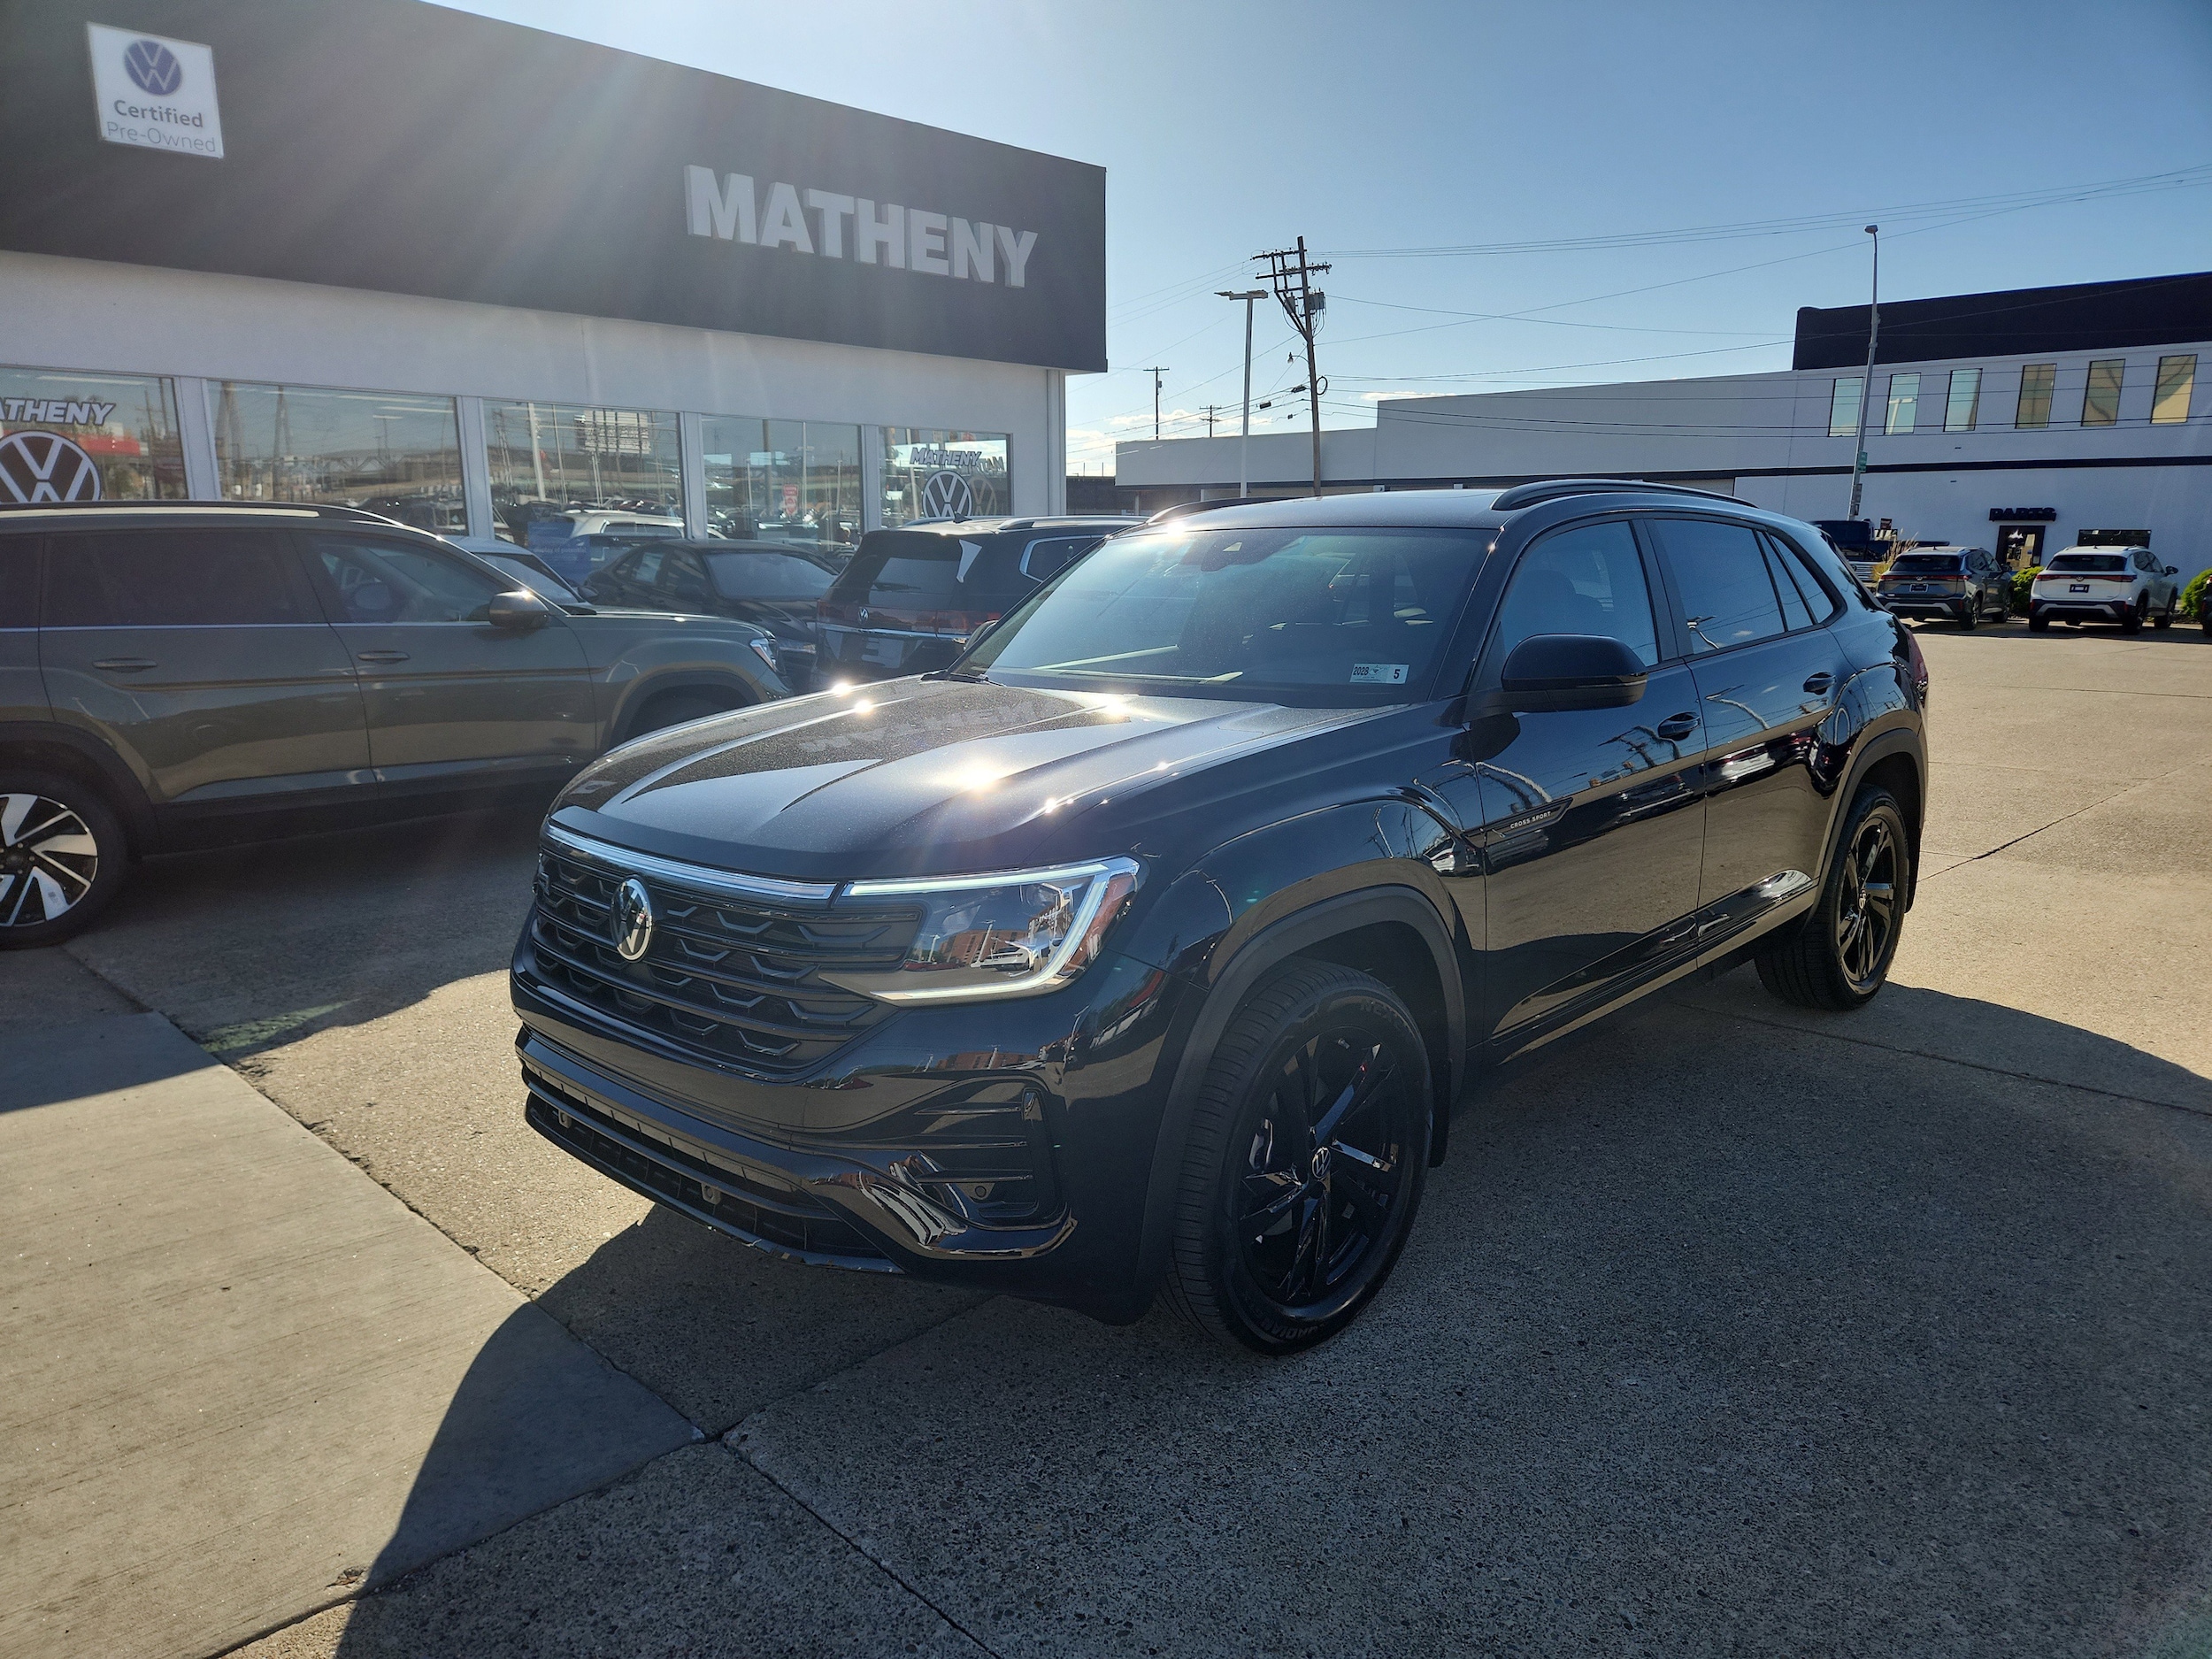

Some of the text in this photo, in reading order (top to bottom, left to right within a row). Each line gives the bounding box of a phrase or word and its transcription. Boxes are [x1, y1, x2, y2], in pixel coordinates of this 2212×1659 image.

[113, 99, 204, 128] Certified
[106, 120, 216, 153] Pre-Owned
[683, 165, 1039, 288] MATHENY
[0, 396, 116, 426] THENY
[910, 447, 982, 467] MATHENY
[1989, 507, 2057, 521] PARTS
[1394, 669, 1401, 680] 5
[1509, 810, 1551, 829] CROSS SPORT
